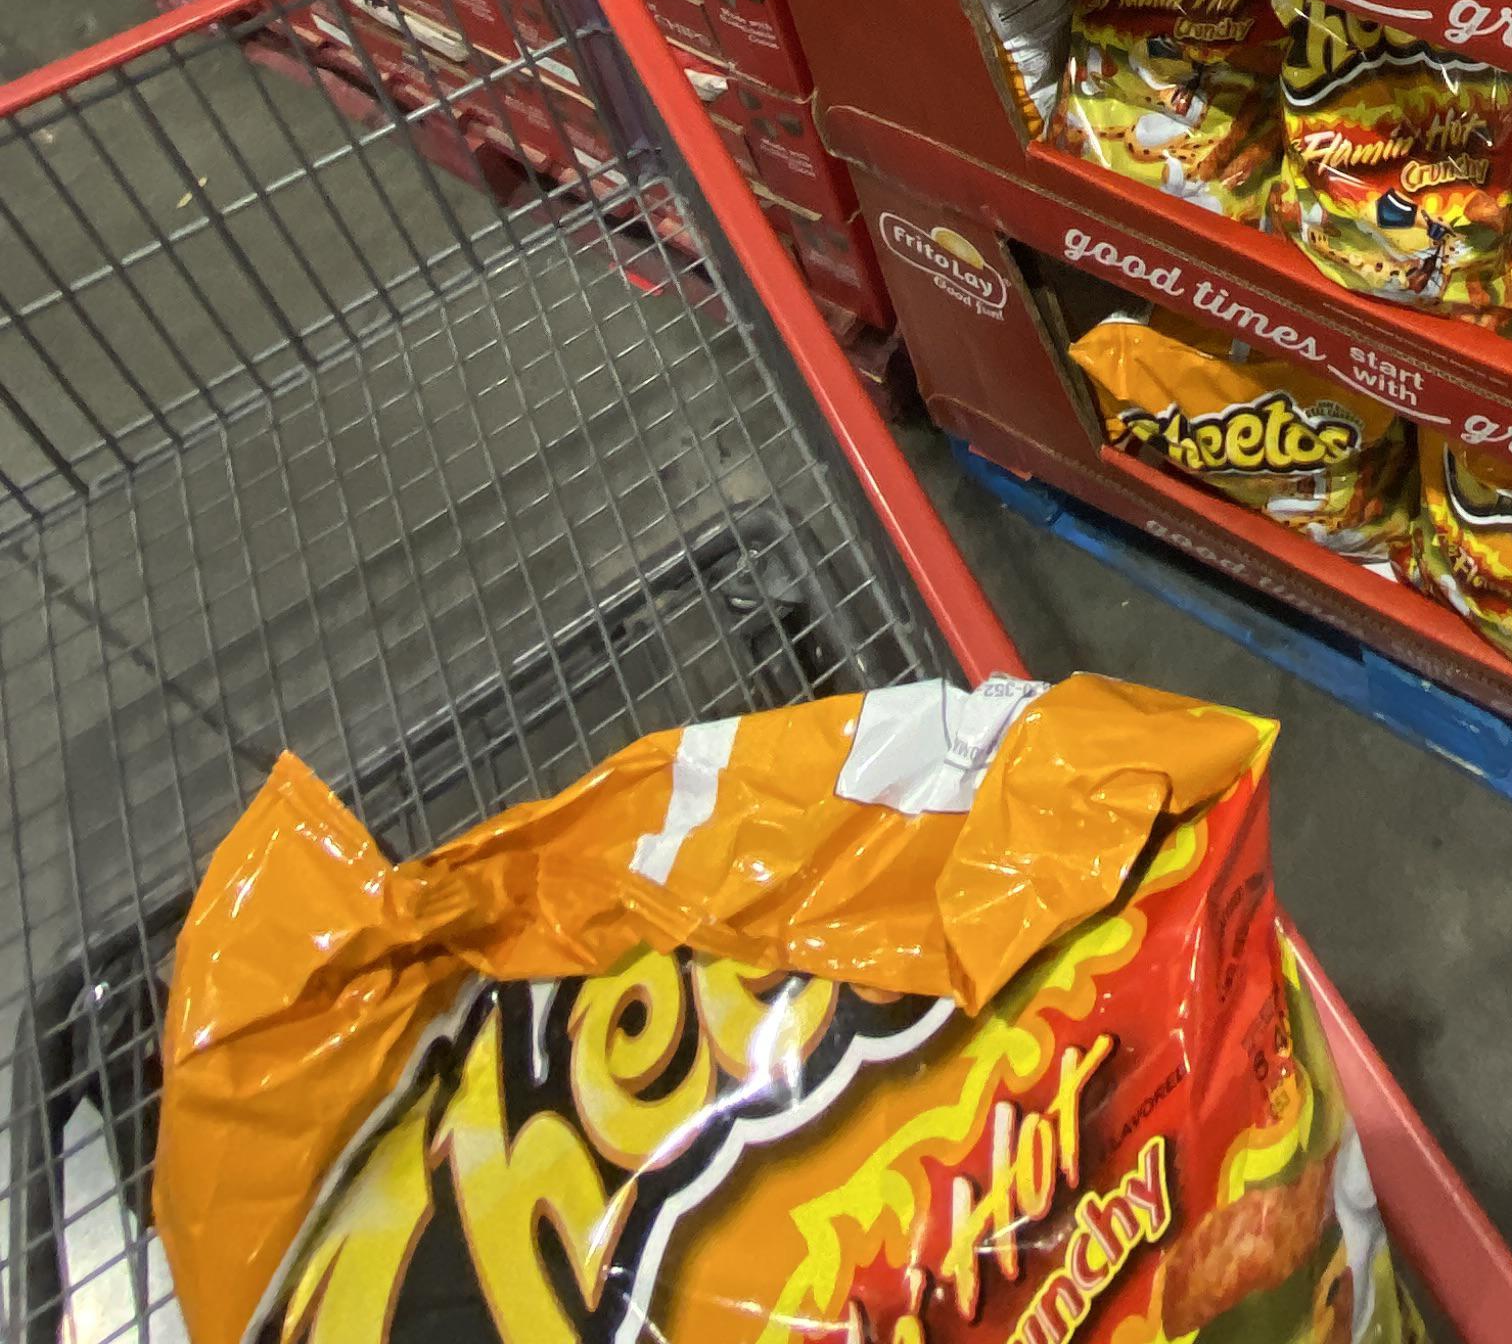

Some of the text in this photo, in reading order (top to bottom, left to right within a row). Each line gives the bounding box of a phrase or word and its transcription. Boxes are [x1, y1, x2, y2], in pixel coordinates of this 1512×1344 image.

[1063, 227, 1327, 363] good times
[1349, 344, 1425, 392] start
[1352, 363, 1420, 408] with
[941, 1031, 1118, 1322] Hot
